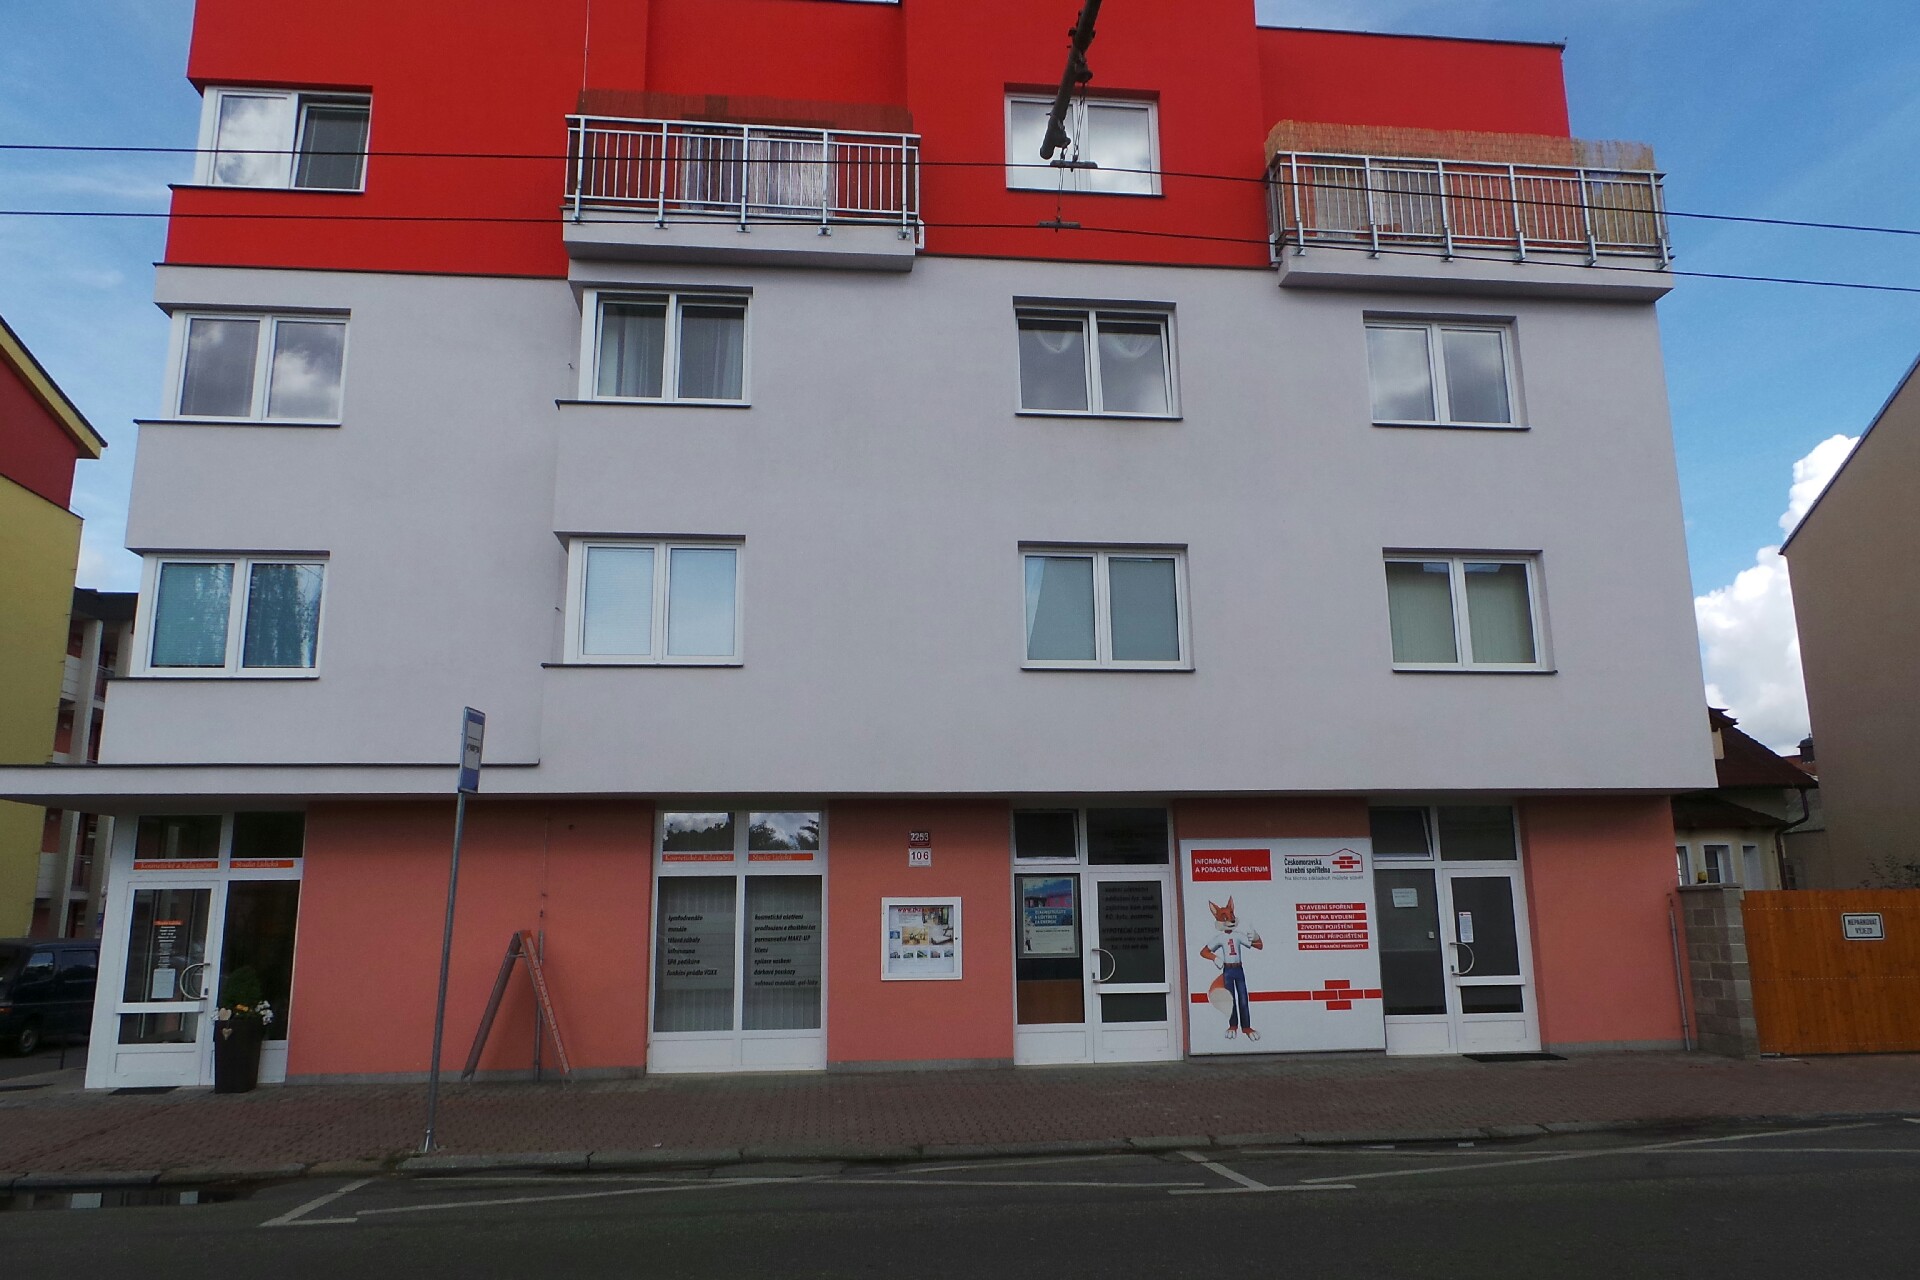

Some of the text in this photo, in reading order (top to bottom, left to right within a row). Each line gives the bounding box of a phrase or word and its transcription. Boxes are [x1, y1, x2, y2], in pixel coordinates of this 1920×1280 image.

[910, 833, 929, 841] 2253
[911, 851, 929, 860] 106
[1284, 858, 1322, 866] Českomoravská
[1201, 865, 1239, 873] PORADENSKÉ
[1306, 866, 1330, 875] spořitelna
